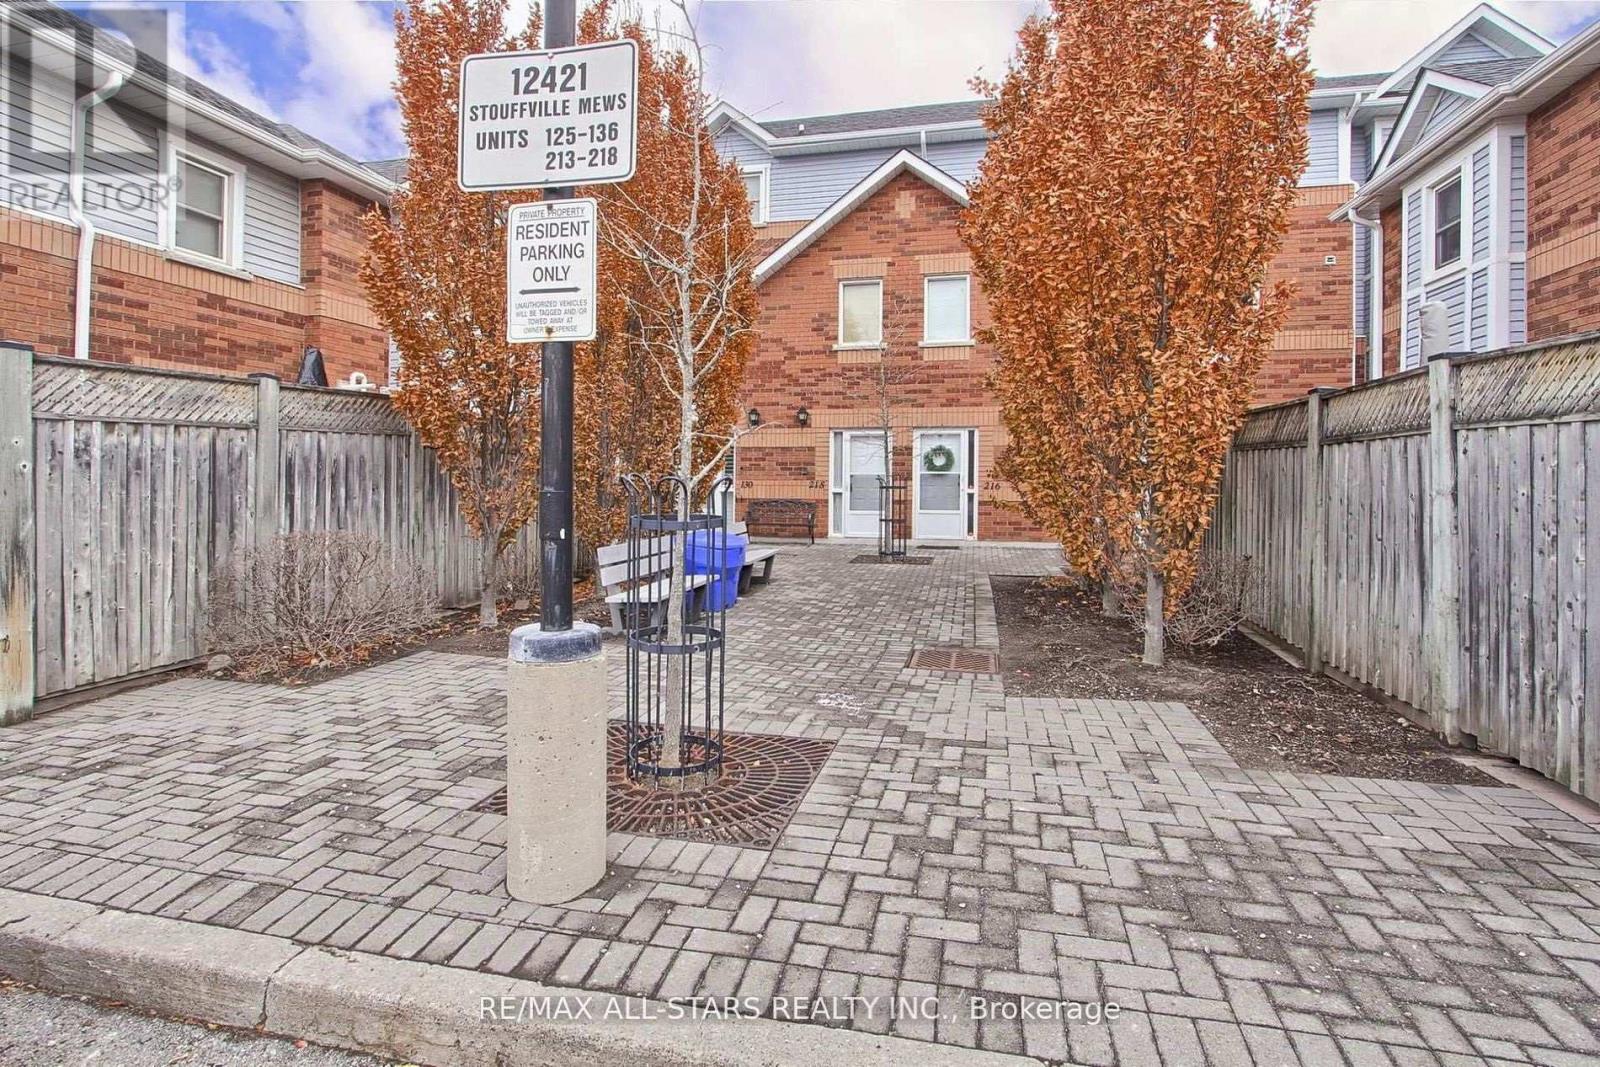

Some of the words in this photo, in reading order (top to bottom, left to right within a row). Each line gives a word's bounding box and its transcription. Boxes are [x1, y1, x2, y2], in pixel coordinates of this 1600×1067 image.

[511, 62, 587, 95] 12421
[469, 99, 570, 121] STOUFFVILLE
[578, 93, 627, 115] MEWS
[476, 129, 529, 151] UNITS
[545, 122, 619, 146] 125-136
[545, 146, 618, 170] 213-218
[519, 210, 545, 219] PRIVATE
[547, 206, 586, 217] PROPERTY
[515, 220, 590, 241] RESIDENT
[520, 242, 585, 262] PARKING
[532, 265, 571, 283] ONLY
[515, 300, 558, 310] UNAUTHORIZED
[560, 299, 588, 307] VEHICLES
[529, 309, 537, 317] BE
[539, 308, 562, 316] TAGGED
[528, 317, 548, 325] TOWED
[566, 316, 573, 324] AT
[740, 480, 754, 489] 130
[808, 480, 825, 489] 218
[983, 481, 1001, 490] 216
